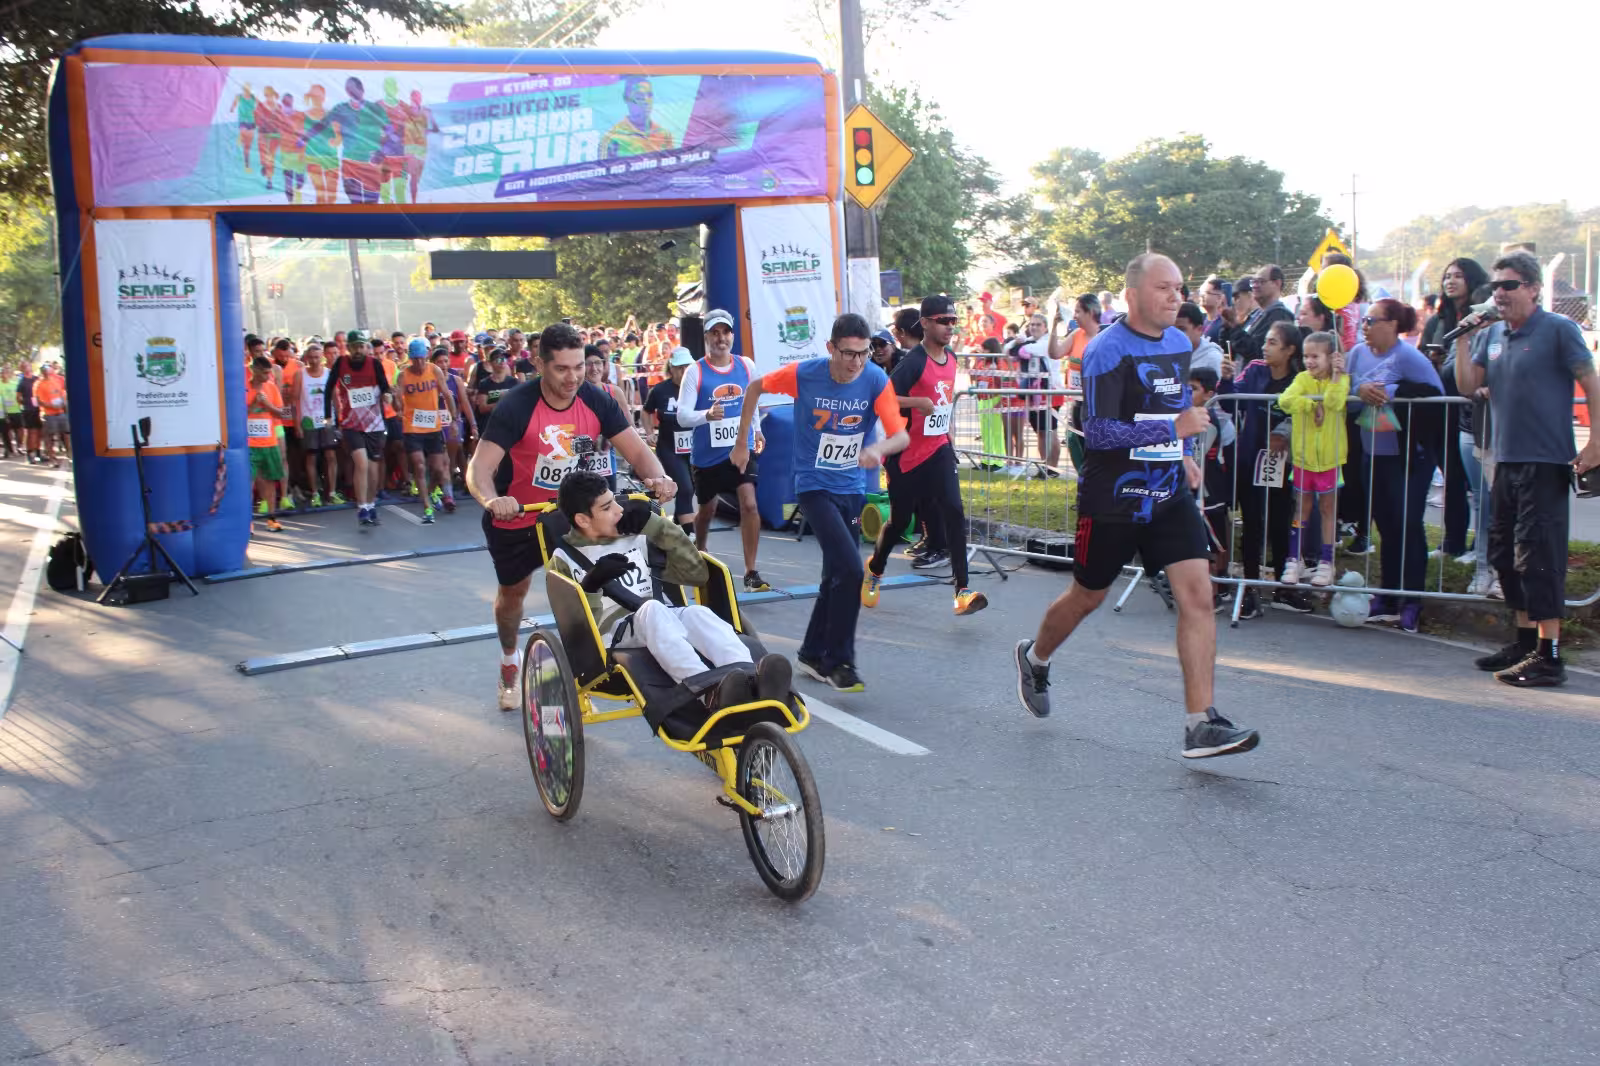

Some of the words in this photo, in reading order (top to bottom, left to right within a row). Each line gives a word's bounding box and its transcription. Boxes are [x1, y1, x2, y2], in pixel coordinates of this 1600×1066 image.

[553, 94, 581, 110] DE
[438, 108, 593, 149] CORRIDA
[454, 153, 495, 177] DE
[496, 130, 599, 175] RUA
[504, 180, 526, 191] EM
[529, 167, 606, 187] HOMENAGEM
[610, 164, 626, 174] AO
[661, 156, 677, 167] DO
[680, 151, 711, 163] PULO
[118, 284, 196, 298] SEMELP
[352, 392, 372, 404] 5003
[815, 397, 869, 411] TREINÃO
[823, 443, 858, 461] 0743
